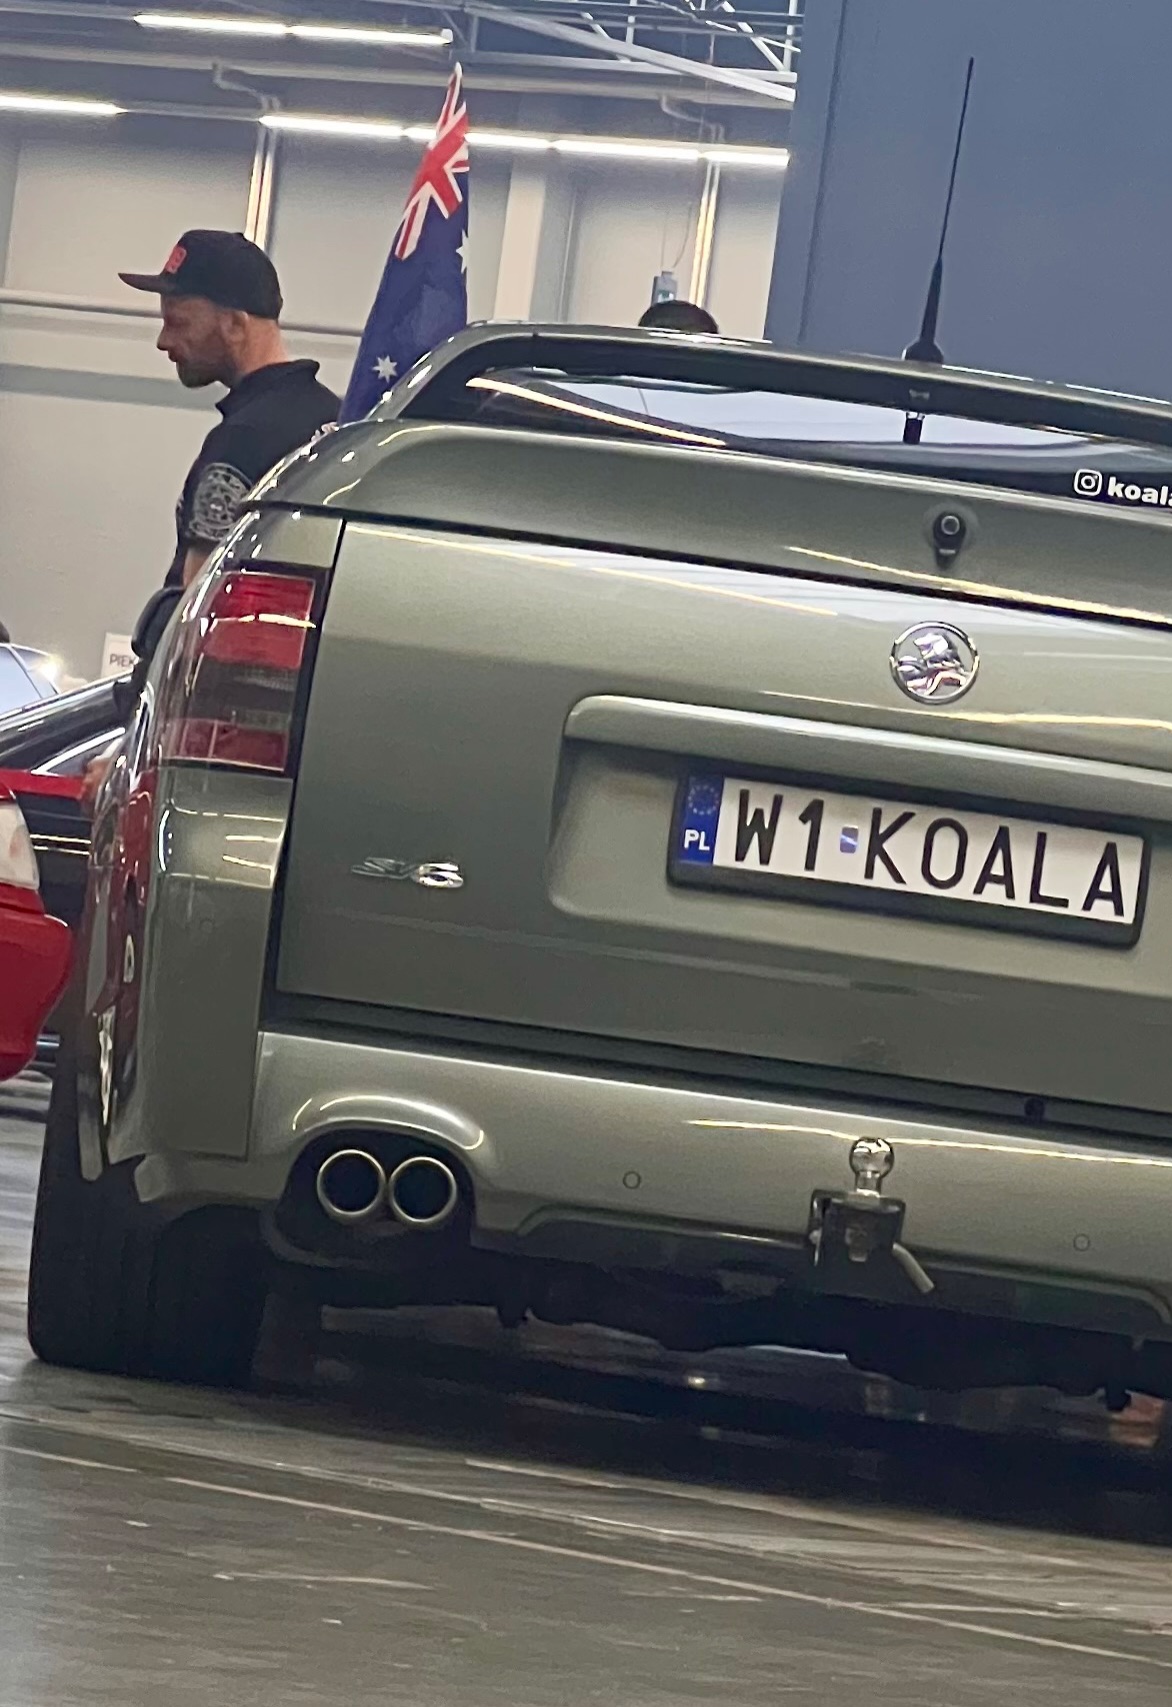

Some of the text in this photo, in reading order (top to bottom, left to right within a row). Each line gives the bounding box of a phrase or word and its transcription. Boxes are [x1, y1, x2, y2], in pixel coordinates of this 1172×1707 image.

[683, 829, 710, 851] PL
[734, 788, 1125, 918] W1 KOALA
